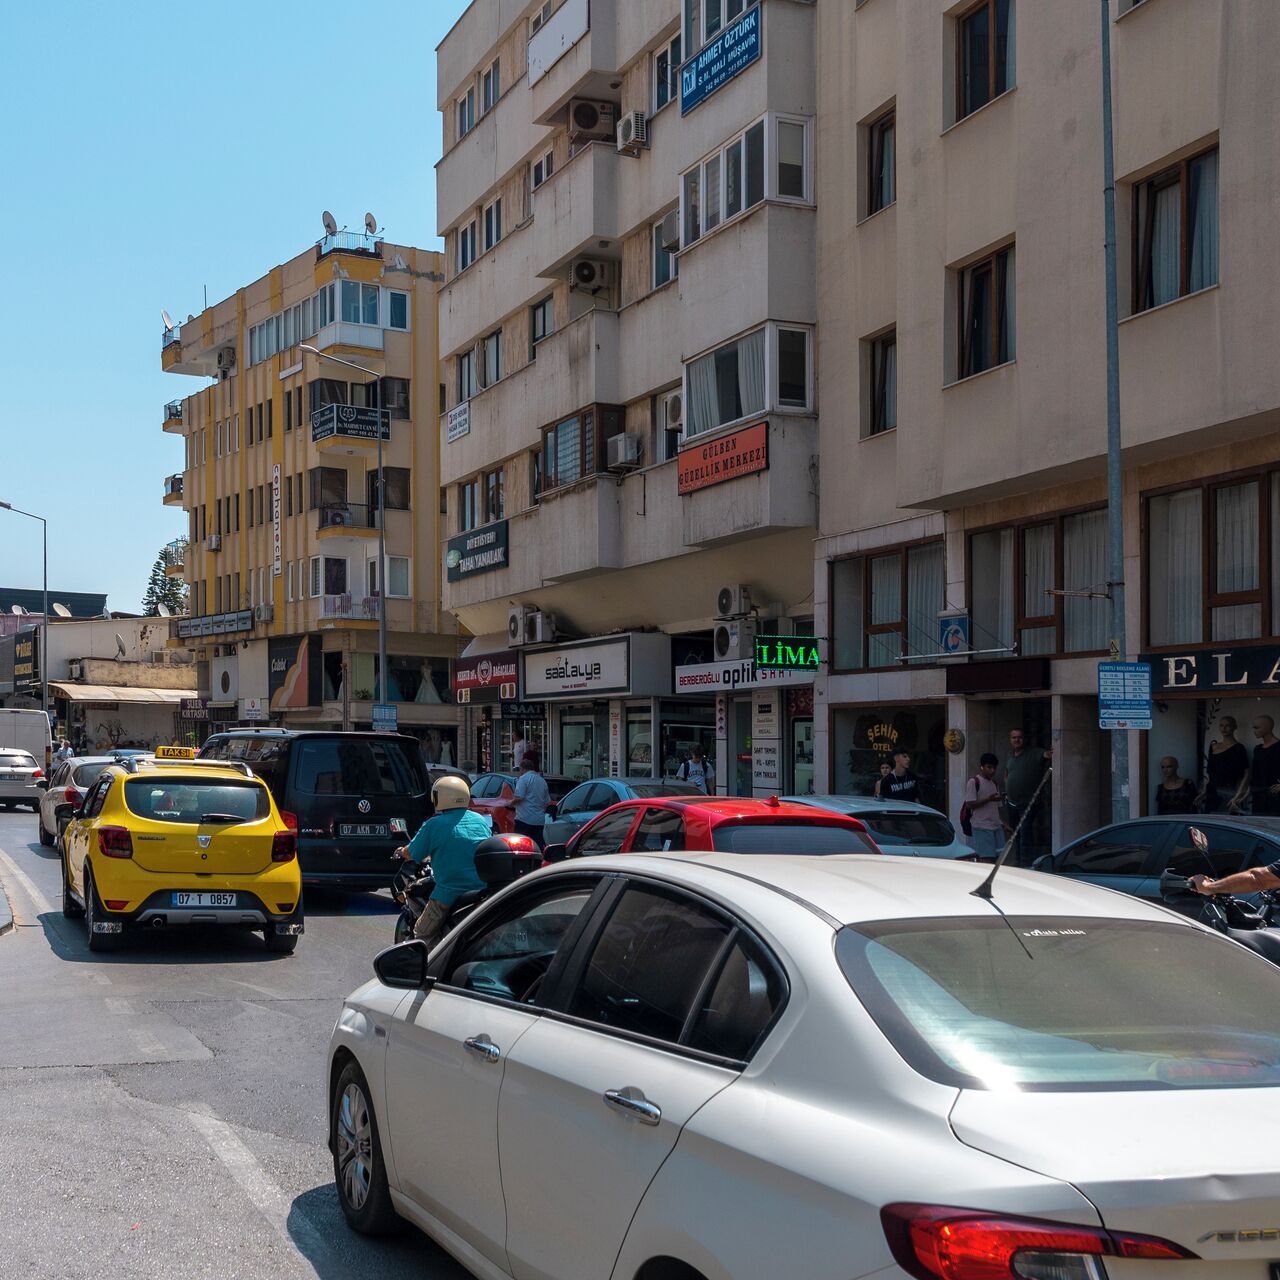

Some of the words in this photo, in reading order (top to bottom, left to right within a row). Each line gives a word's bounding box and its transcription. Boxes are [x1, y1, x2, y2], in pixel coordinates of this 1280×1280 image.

[698, 40, 723, 71] AHMET
[724, 12, 756, 48] ÖZTÜRK
[702, 438, 737, 460] GÜLBEN
[722, 442, 766, 471] MERKEZİ
[757, 641, 819, 665] LİMA
[679, 672, 720, 686] BERBEROĞLU
[723, 664, 758, 689] optik
[867, 724, 899, 744] ŞEHİR
[872, 743, 893, 752] OTEL
[341, 825, 352, 834] 07
[178, 894, 191, 905] 07
[196, 894, 203, 905] T
[210, 894, 235, 905] 0857
